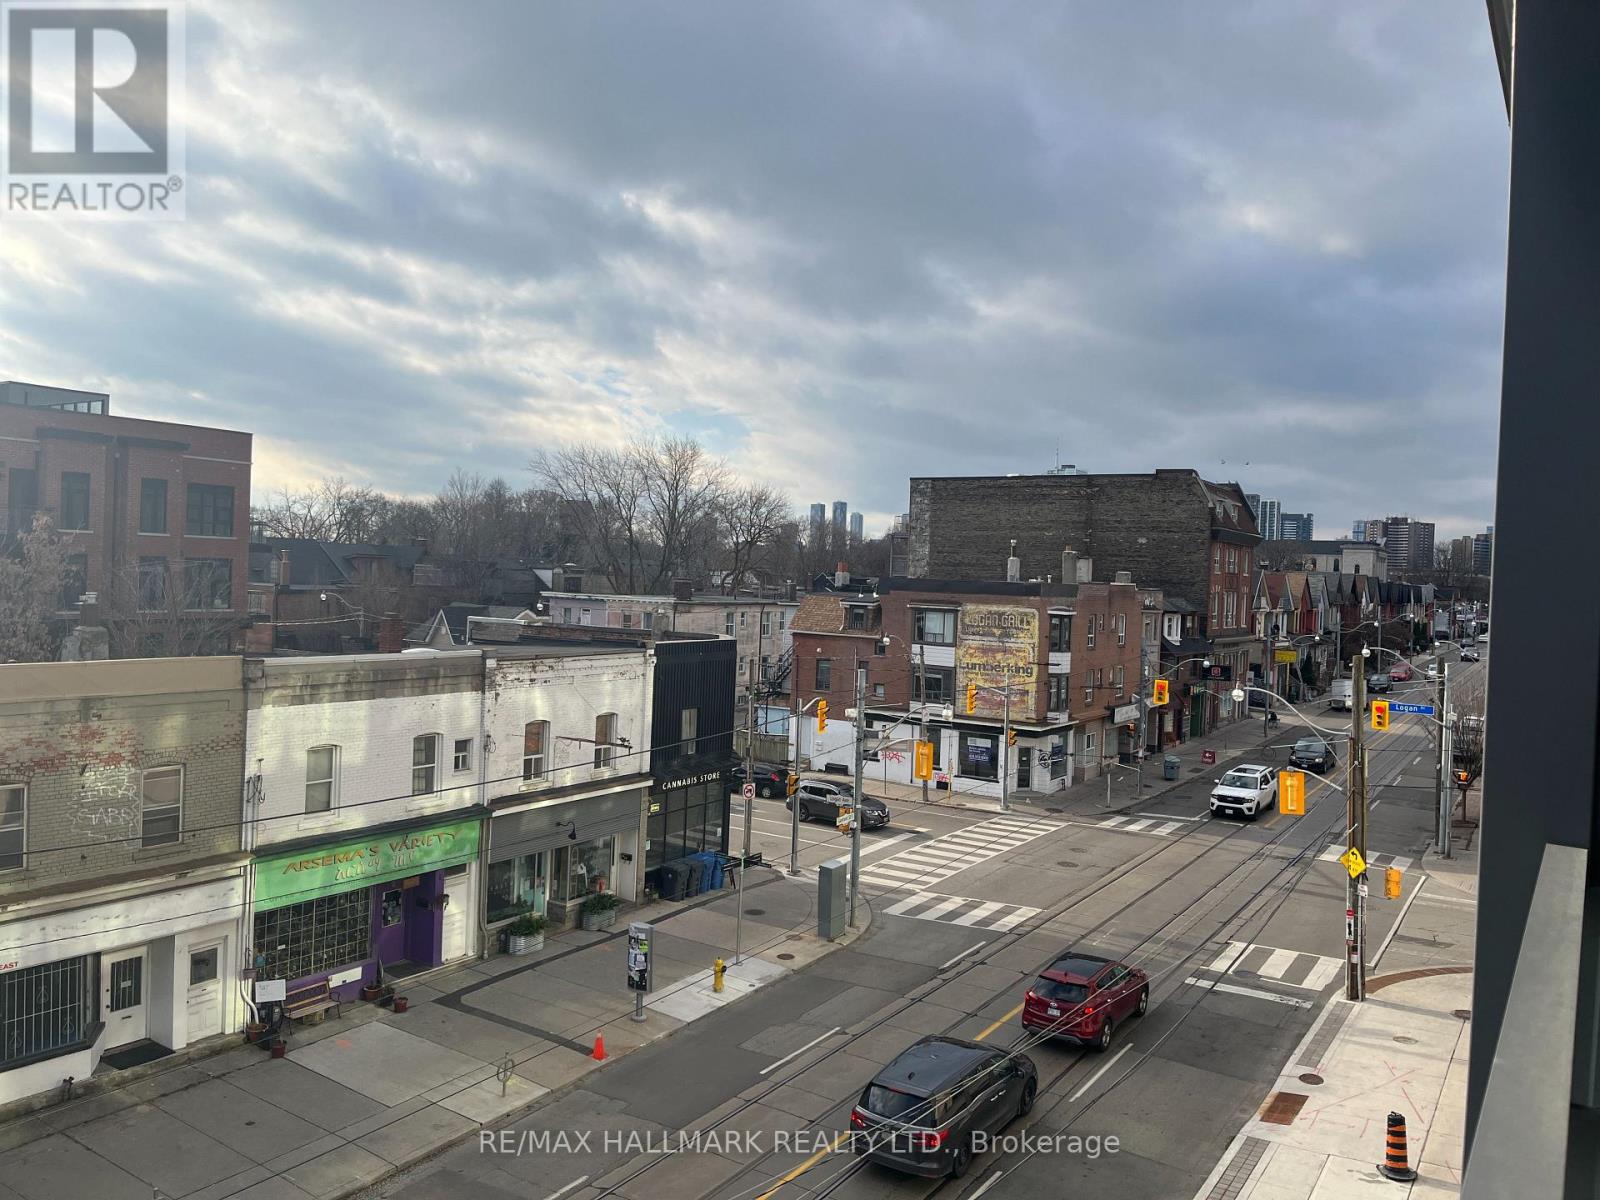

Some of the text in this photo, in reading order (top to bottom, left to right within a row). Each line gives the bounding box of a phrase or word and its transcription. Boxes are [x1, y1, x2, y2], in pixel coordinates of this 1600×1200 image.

[1395, 704, 1418, 713] Logan
[662, 771, 720, 790] CANNABIS STORE
[283, 844, 379, 875] ARSEMA'S
[388, 827, 464, 853] VARIETY
